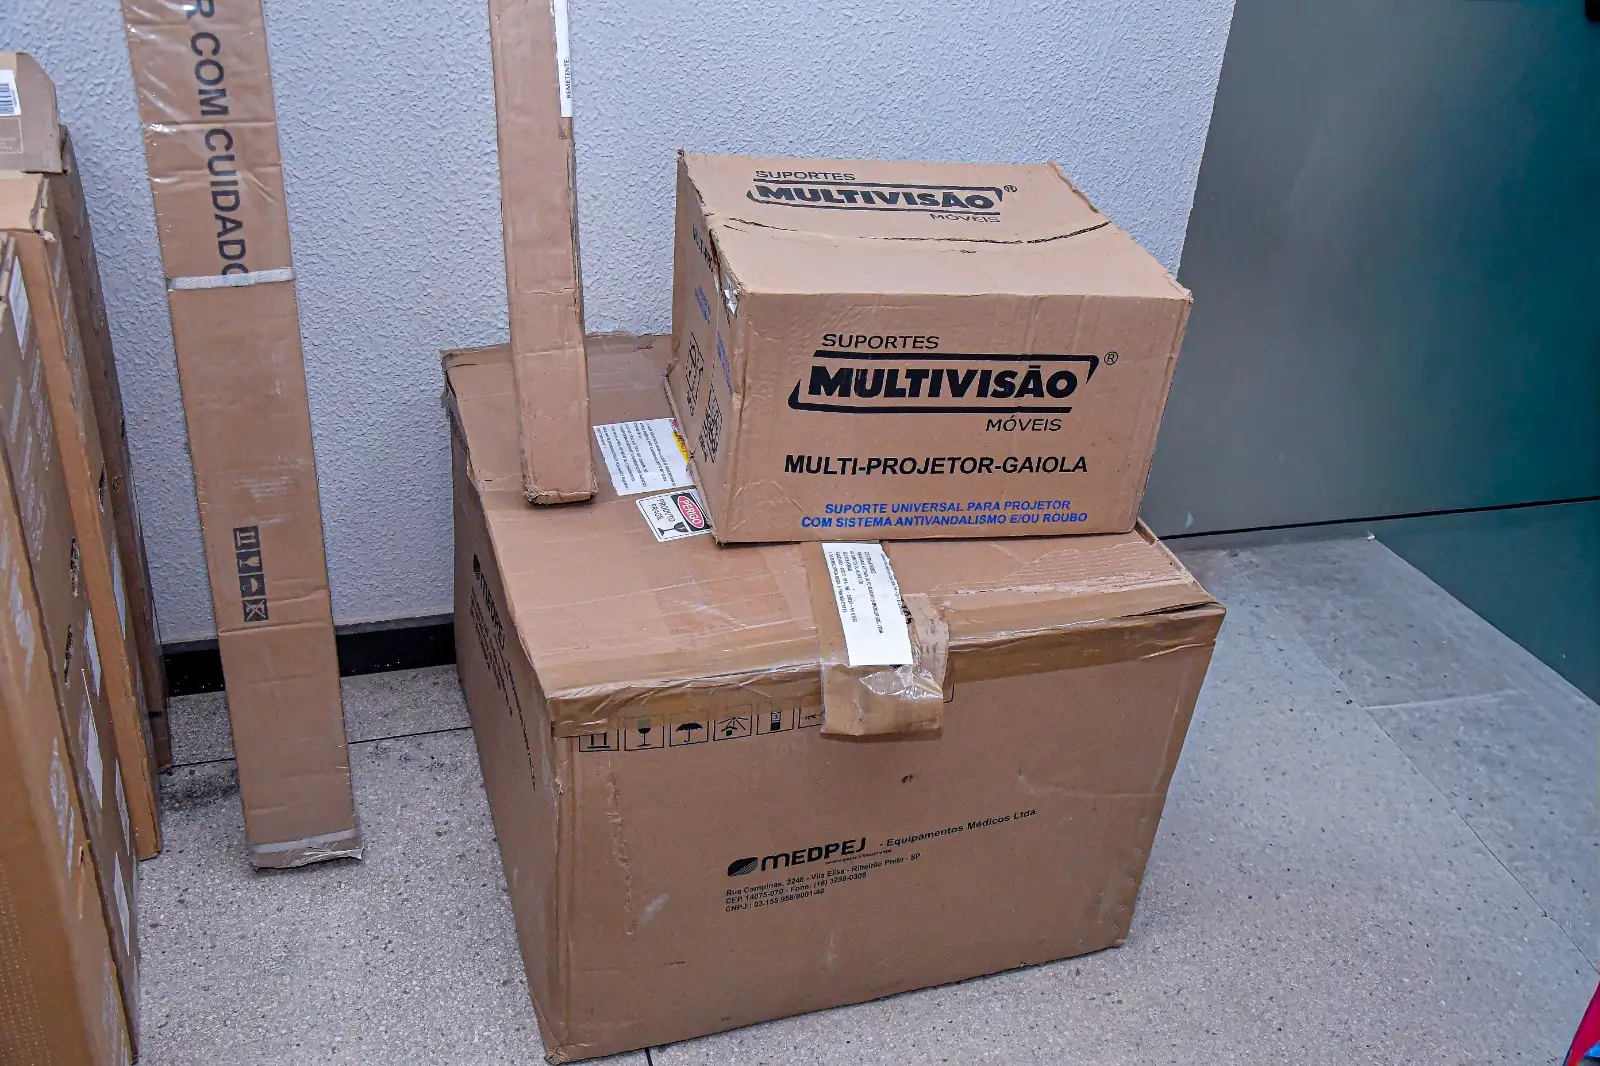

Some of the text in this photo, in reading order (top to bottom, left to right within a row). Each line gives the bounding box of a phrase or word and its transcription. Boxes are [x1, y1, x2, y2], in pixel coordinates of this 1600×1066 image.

[191, 32, 229, 116] COM
[755, 170, 856, 182] SUPORTES
[754, 184, 995, 210] MULTIVISÃO
[930, 212, 1001, 223] MÓVEIS
[821, 333, 939, 350] SUPORTES
[807, 364, 1078, 399] MULTIVISÃO
[985, 414, 1062, 432] MÓVEIS
[784, 454, 1088, 476] MULTI-PROJETOR-GAIOLA
[679, 499, 702, 525] PERIGO
[824, 500, 1071, 515] SUPORTE UNIVERSAL PARA PROJETOR
[800, 512, 1088, 528] COM SISTEMA ANTIVANDALISMO E/OU ROUBO
[885, 825, 964, 847] Equipamentos
[966, 814, 1010, 830] Médicos
[1013, 808, 1039, 820] Ltda.
[726, 888, 742, 897] Rua
[811, 872, 825, 881] Vila
